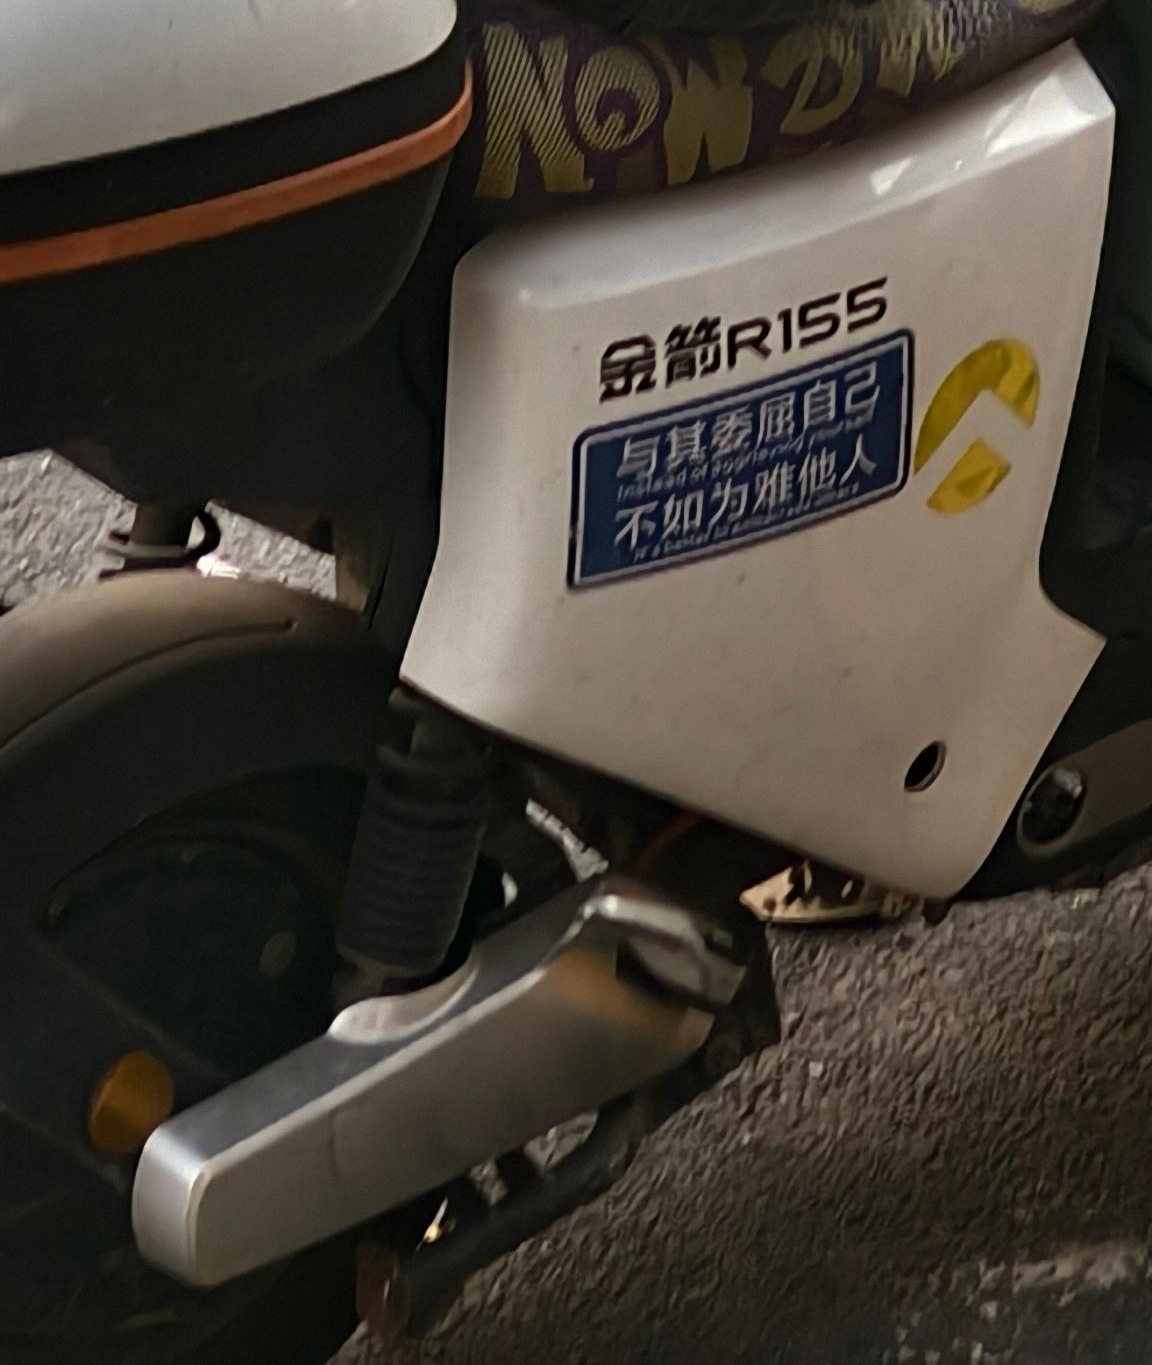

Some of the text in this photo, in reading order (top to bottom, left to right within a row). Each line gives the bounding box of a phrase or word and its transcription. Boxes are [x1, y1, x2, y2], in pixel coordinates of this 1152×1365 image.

[599, 275, 888, 405] 金箭R155
[615, 360, 881, 478] 与其委屈自己
[613, 433, 878, 551] 不如为难他人
